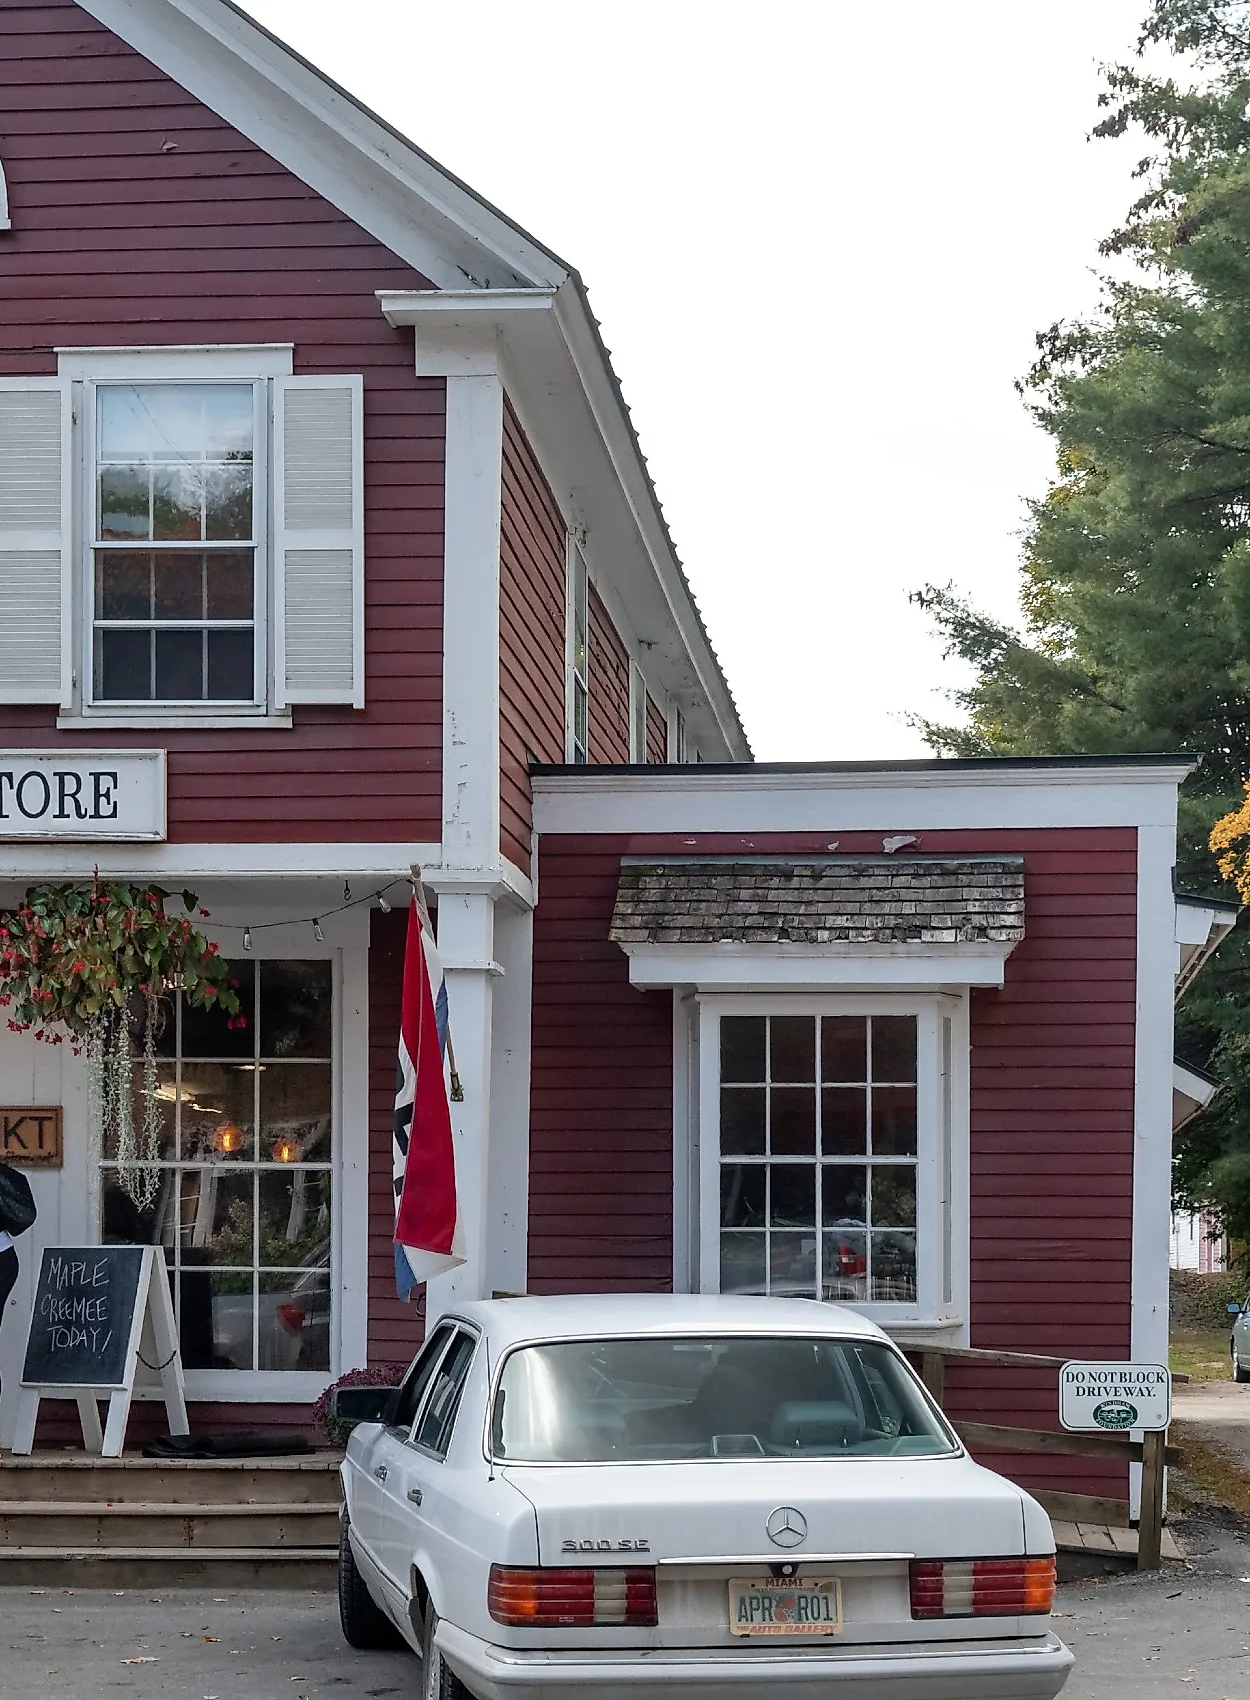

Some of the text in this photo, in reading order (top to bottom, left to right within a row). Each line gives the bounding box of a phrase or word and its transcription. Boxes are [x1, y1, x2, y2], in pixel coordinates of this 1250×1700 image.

[47, 1256, 110, 1291] MAPLE
[40, 1293, 108, 1324] CREEMEE
[1065, 1371, 1166, 1383] DO NOT BLOCK
[1075, 1386, 1156, 1398] DRIVEWAY.
[562, 1539, 650, 1551] 300 SE
[765, 1579, 804, 1587] MIAMI
[737, 1596, 774, 1622] APR
[750, 1625, 782, 1634] AUTO
[784, 1625, 837, 1634] GALLERY
